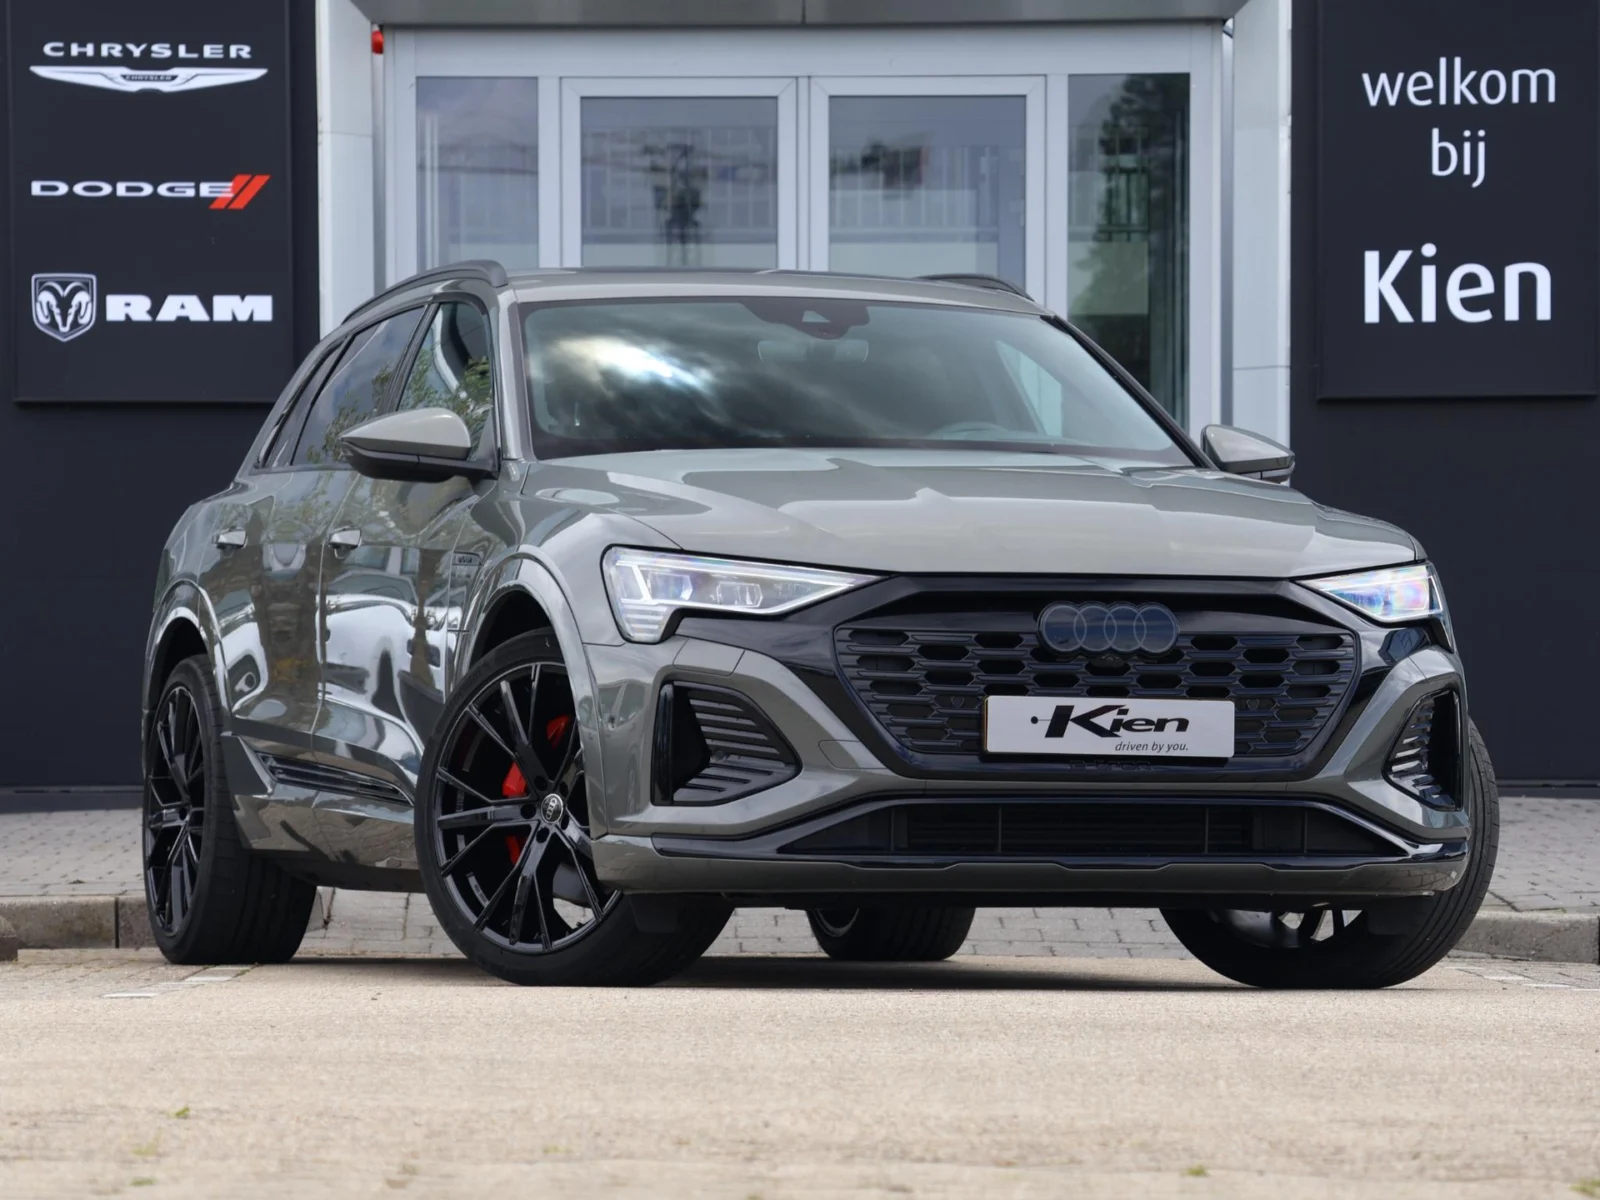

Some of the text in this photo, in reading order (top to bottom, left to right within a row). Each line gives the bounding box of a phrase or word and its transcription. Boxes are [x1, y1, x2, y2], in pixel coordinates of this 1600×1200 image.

[43, 42, 252, 59] CHRYSLER
[1361, 56, 1556, 107] welkom
[1431, 127, 1486, 188] bij
[31, 180, 235, 197] DODGE
[1364, 243, 1551, 323] Kien
[106, 295, 273, 321] RAM
[1045, 704, 1190, 738] Kien
[1115, 741, 1189, 754] driven by you.
